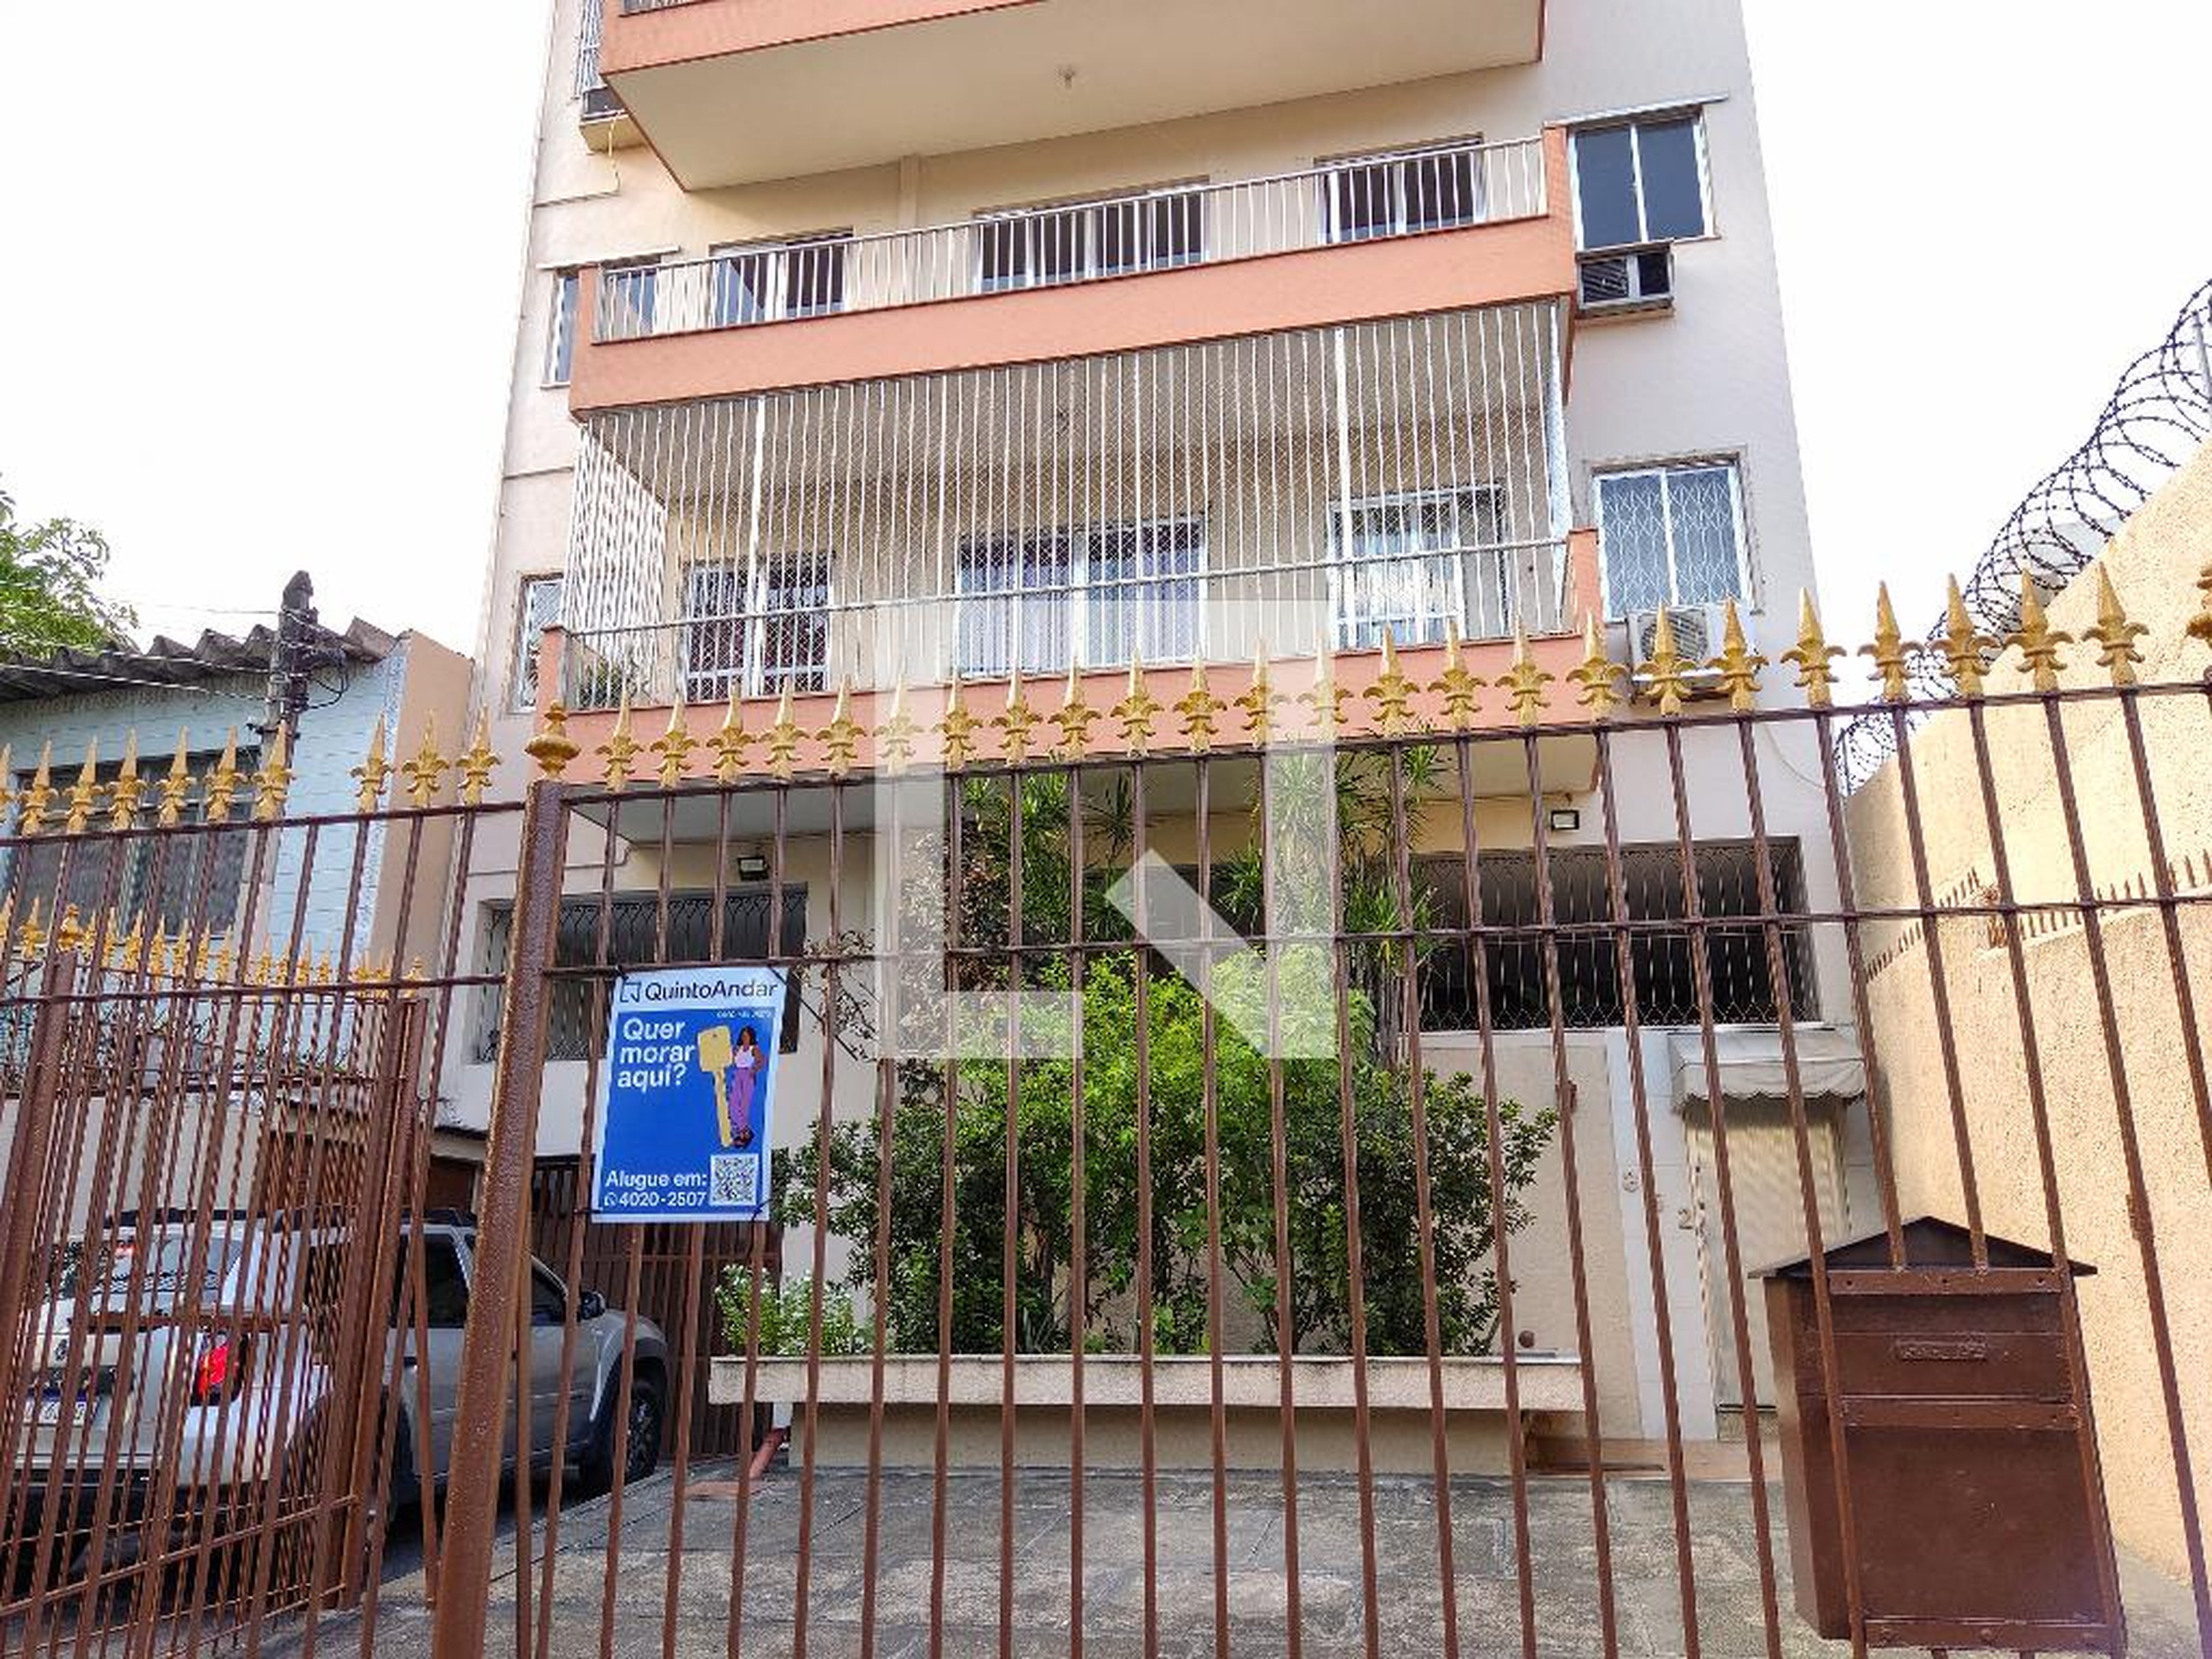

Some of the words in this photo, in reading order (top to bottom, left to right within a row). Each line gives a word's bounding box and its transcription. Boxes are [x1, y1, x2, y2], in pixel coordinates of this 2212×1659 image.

[645, 980, 778, 1001] QuintoAndar
[623, 1017, 685, 1040] Quer
[620, 1045, 695, 1063] morar
[618, 1063, 687, 1093] aqui?
[605, 1170, 669, 1191] Alugue
[673, 1173, 707, 1187] em:
[619, 1192, 707, 1206] 4020-2507
